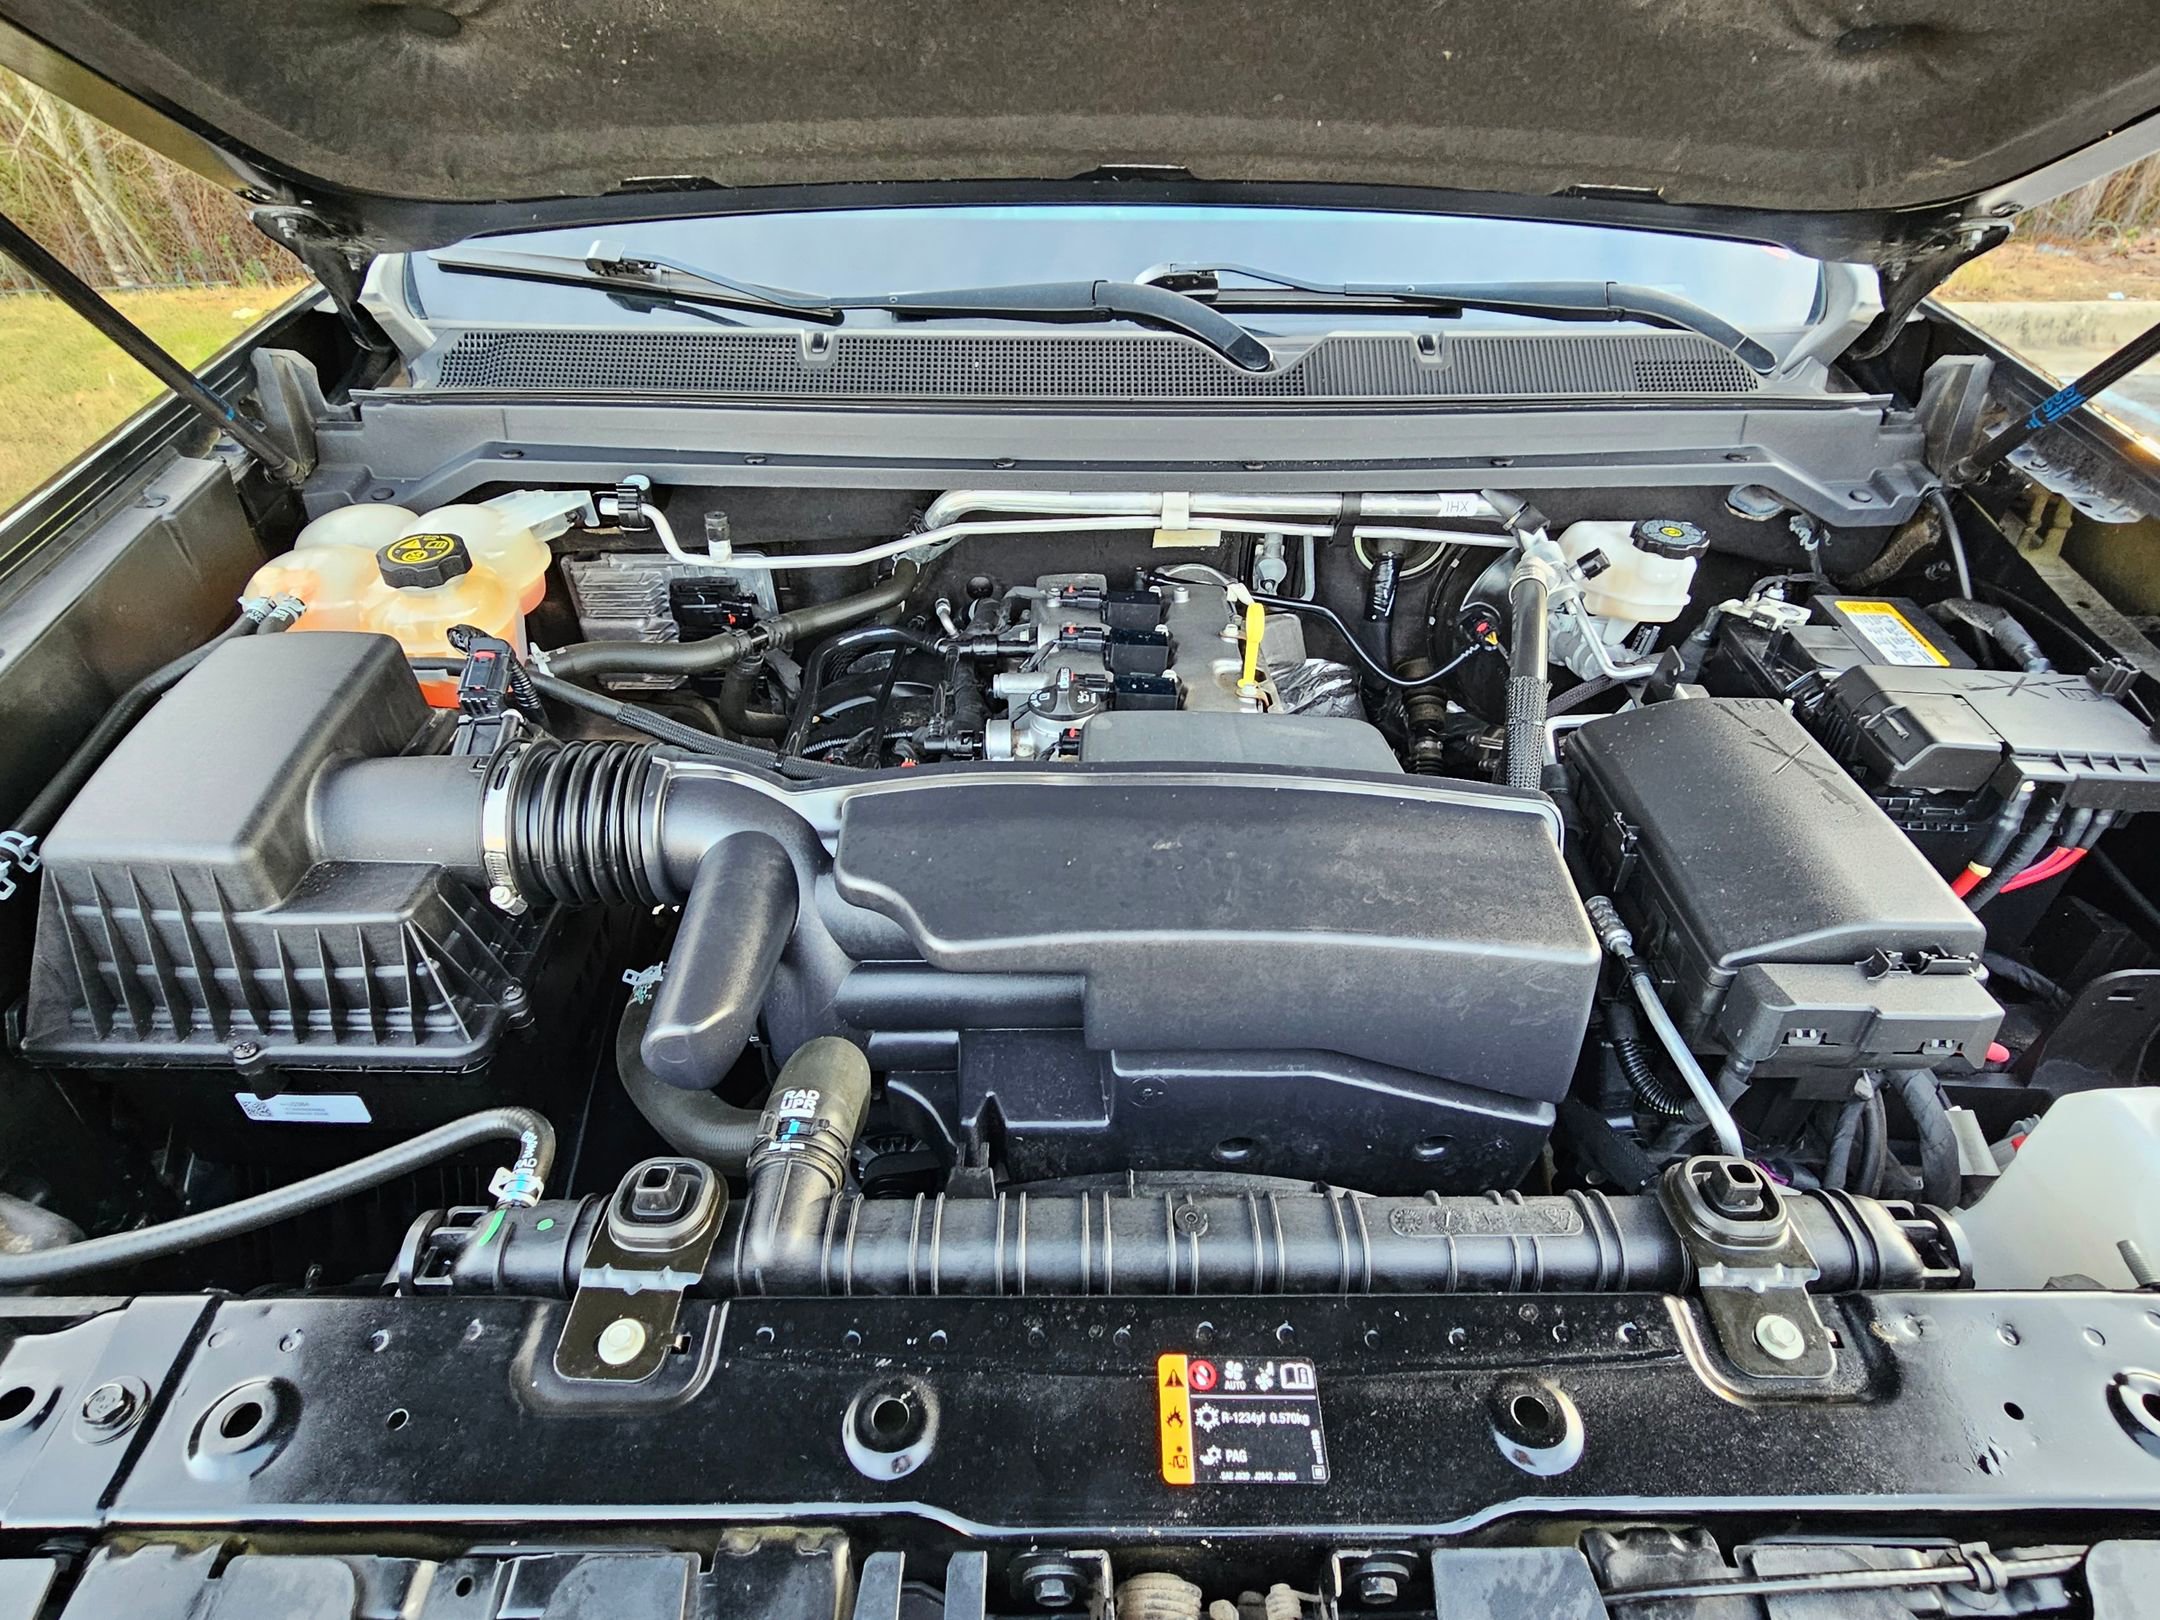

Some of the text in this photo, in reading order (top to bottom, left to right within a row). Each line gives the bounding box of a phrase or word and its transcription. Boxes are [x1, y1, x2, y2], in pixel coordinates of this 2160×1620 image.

[783, 1089, 820, 1101] RAD
[780, 1099, 817, 1111] UPR
[1224, 1380, 1246, 1391] AUTO
[1225, 1448, 1248, 1463] PAG
